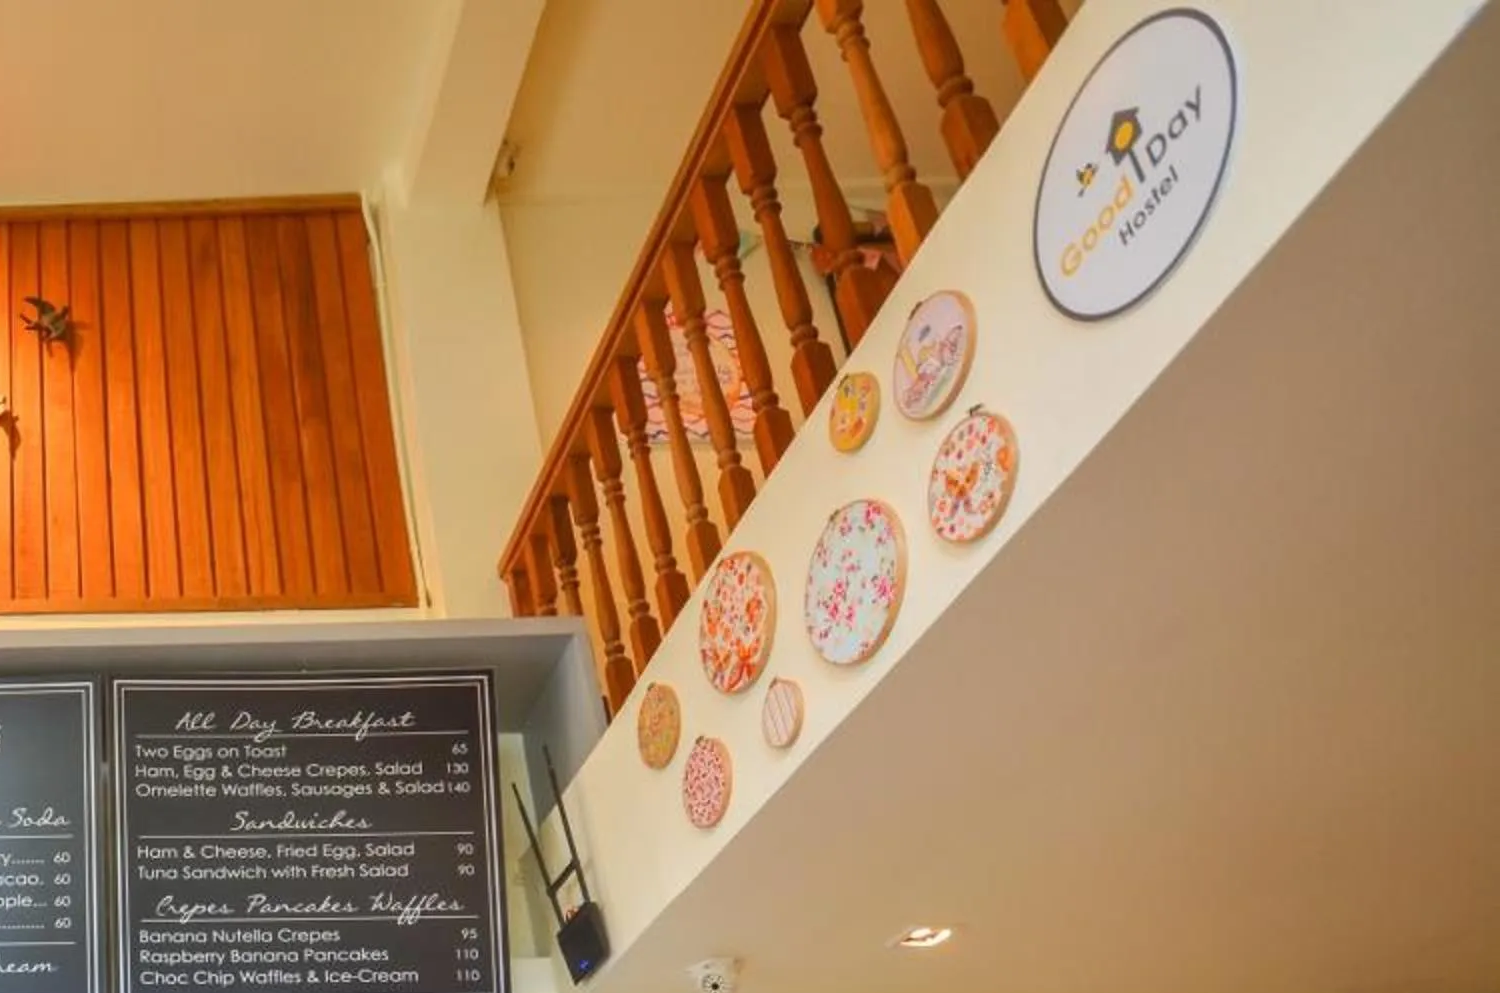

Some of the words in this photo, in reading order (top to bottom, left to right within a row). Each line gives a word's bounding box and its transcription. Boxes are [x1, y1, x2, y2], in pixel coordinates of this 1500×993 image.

[1060, 174, 1134, 277] Good
[1146, 85, 1202, 167] Day
[1118, 164, 1180, 246] Hostel
[174, 711, 216, 732] All
[227, 711, 285, 743] Day
[288, 710, 420, 742] Breakfast
[134, 743, 169, 759] Two
[172, 744, 213, 761] Eggs
[216, 747, 240, 759] on
[243, 743, 288, 759] Toast
[134, 764, 179, 779] Ham,
[183, 764, 217, 781] Egg
[220, 764, 233, 779] &
[237, 763, 302, 778] Cheese
[374, 760, 423, 776] Salad
[135, 783, 217, 798] Omelette
[291, 782, 373, 799] Sausages
[377, 781, 391, 796] &
[395, 779, 445, 795] Salad
[447, 780, 471, 793] 140
[9, 806, 71, 828] Soda
[229, 809, 373, 831] Sandwiches
[52, 851, 72, 864] 60
[137, 845, 179, 859] Ham
[182, 845, 196, 860] &
[276, 844, 318, 858] Fried
[365, 841, 416, 857] Salad
[456, 842, 475, 856] 90
[53, 872, 72, 886] 60
[137, 865, 179, 881] Tuna
[182, 865, 268, 880] Sandwich
[270, 865, 308, 879] with
[310, 864, 356, 879] Fresh
[358, 863, 409, 878] Salad
[457, 863, 476, 877] 90
[53, 895, 72, 908] 60
[153, 894, 238, 925] Crepes
[246, 893, 359, 914] Pancakes
[367, 891, 468, 926] Waffles
[54, 916, 72, 929] 60
[139, 929, 208, 944] Banana
[211, 928, 273, 943] Nutella
[277, 927, 341, 945] Crepes
[139, 949, 225, 966] Raspberry
[229, 949, 299, 964] Banana
[303, 947, 389, 963] Pancakes
[139, 970, 189, 985] Choc
[192, 970, 235, 988] Chip
[238, 969, 302, 985] Waffles
[306, 969, 320, 984] &
[324, 968, 420, 983] Ice-Cream
